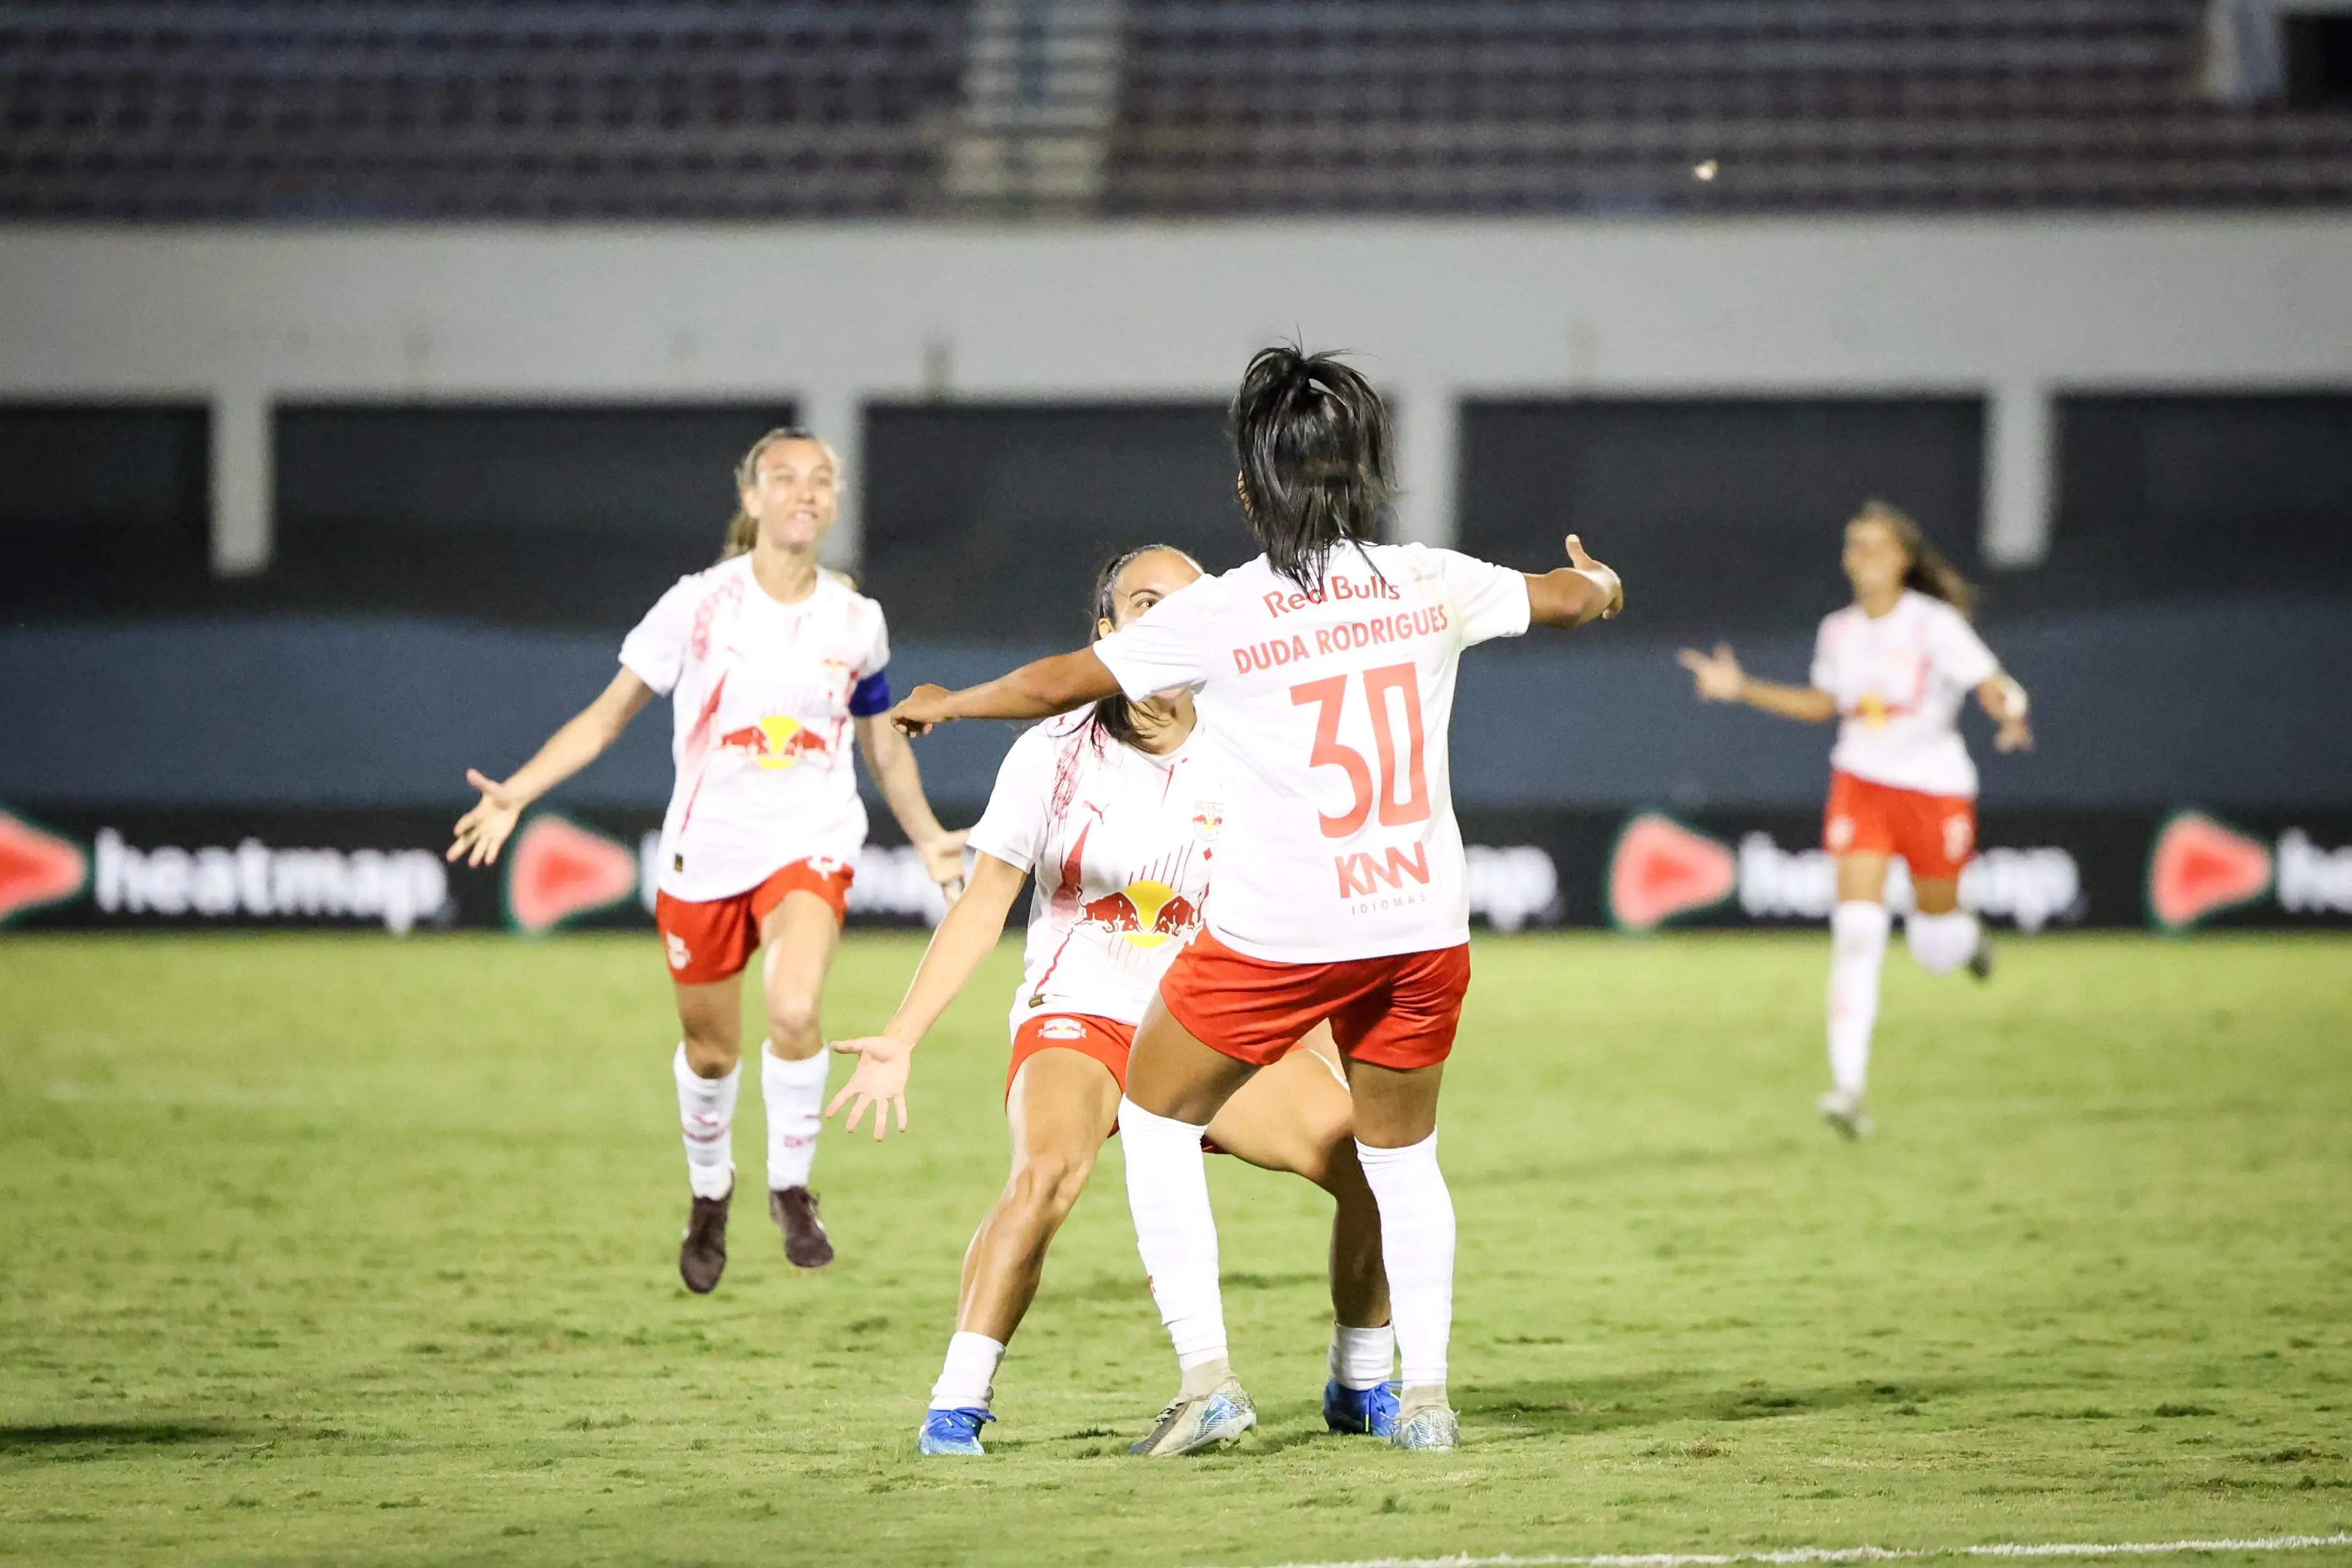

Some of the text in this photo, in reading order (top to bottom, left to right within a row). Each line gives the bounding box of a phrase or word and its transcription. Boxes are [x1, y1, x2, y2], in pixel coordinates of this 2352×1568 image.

[1331, 575, 1401, 600] Bulls
[1233, 604, 1449, 675] DUDA RODRIGUES
[1289, 662, 1432, 839] 30
[94, 827, 448, 934] heatmap
[1335, 841, 1430, 899] KNN
[1351, 893, 1427, 915] IDIOMAS
